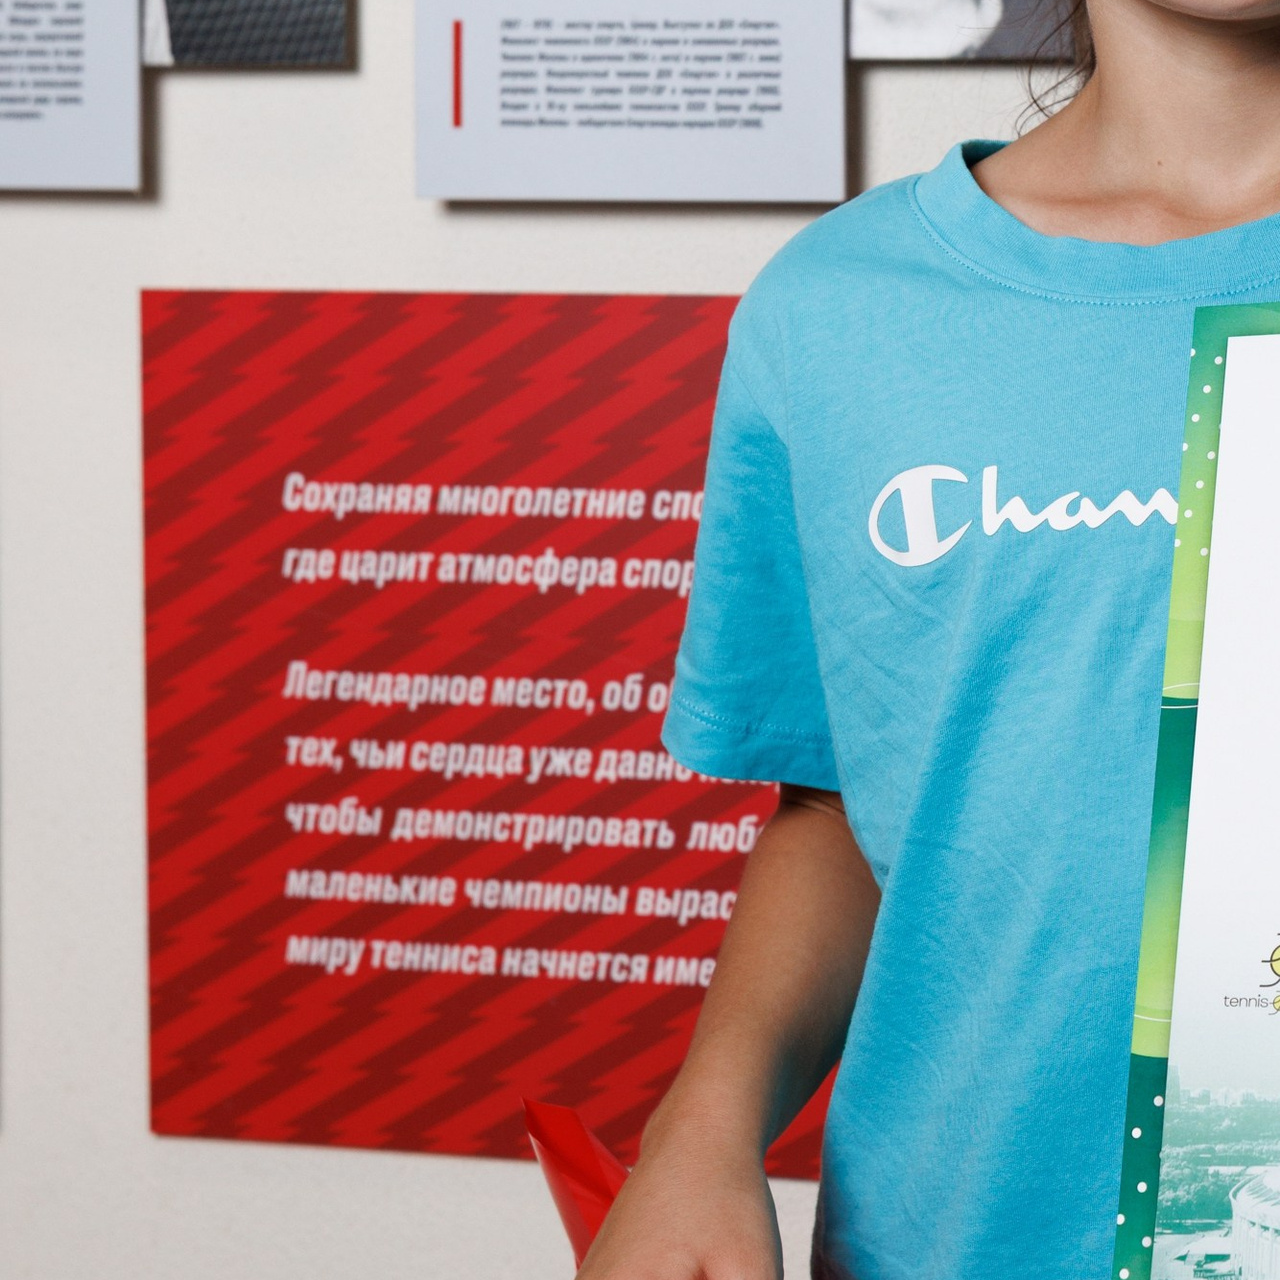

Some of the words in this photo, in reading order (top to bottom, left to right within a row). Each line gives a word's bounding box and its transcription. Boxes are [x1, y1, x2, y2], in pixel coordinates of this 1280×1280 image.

[282, 472, 431, 521] Сохраняя
[437, 484, 646, 520] многолетние
[282, 548, 334, 583] где
[340, 549, 434, 589] царит
[437, 547, 616, 594] атмосфера
[283, 660, 487, 711] Легендарное
[490, 675, 595, 715] место,
[602, 674, 645, 712] об
[285, 735, 343, 772] тех,
[349, 738, 407, 769] чьи
[410, 742, 523, 780] сердца
[528, 746, 591, 783] уже
[285, 796, 383, 836] чтобы
[391, 807, 675, 853] демонстрировать
[285, 870, 457, 905] маленькие
[464, 878, 628, 915] чемпионы
[285, 935, 365, 975] миру
[370, 939, 496, 975] тенниса
[501, 946, 648, 984] начнется
